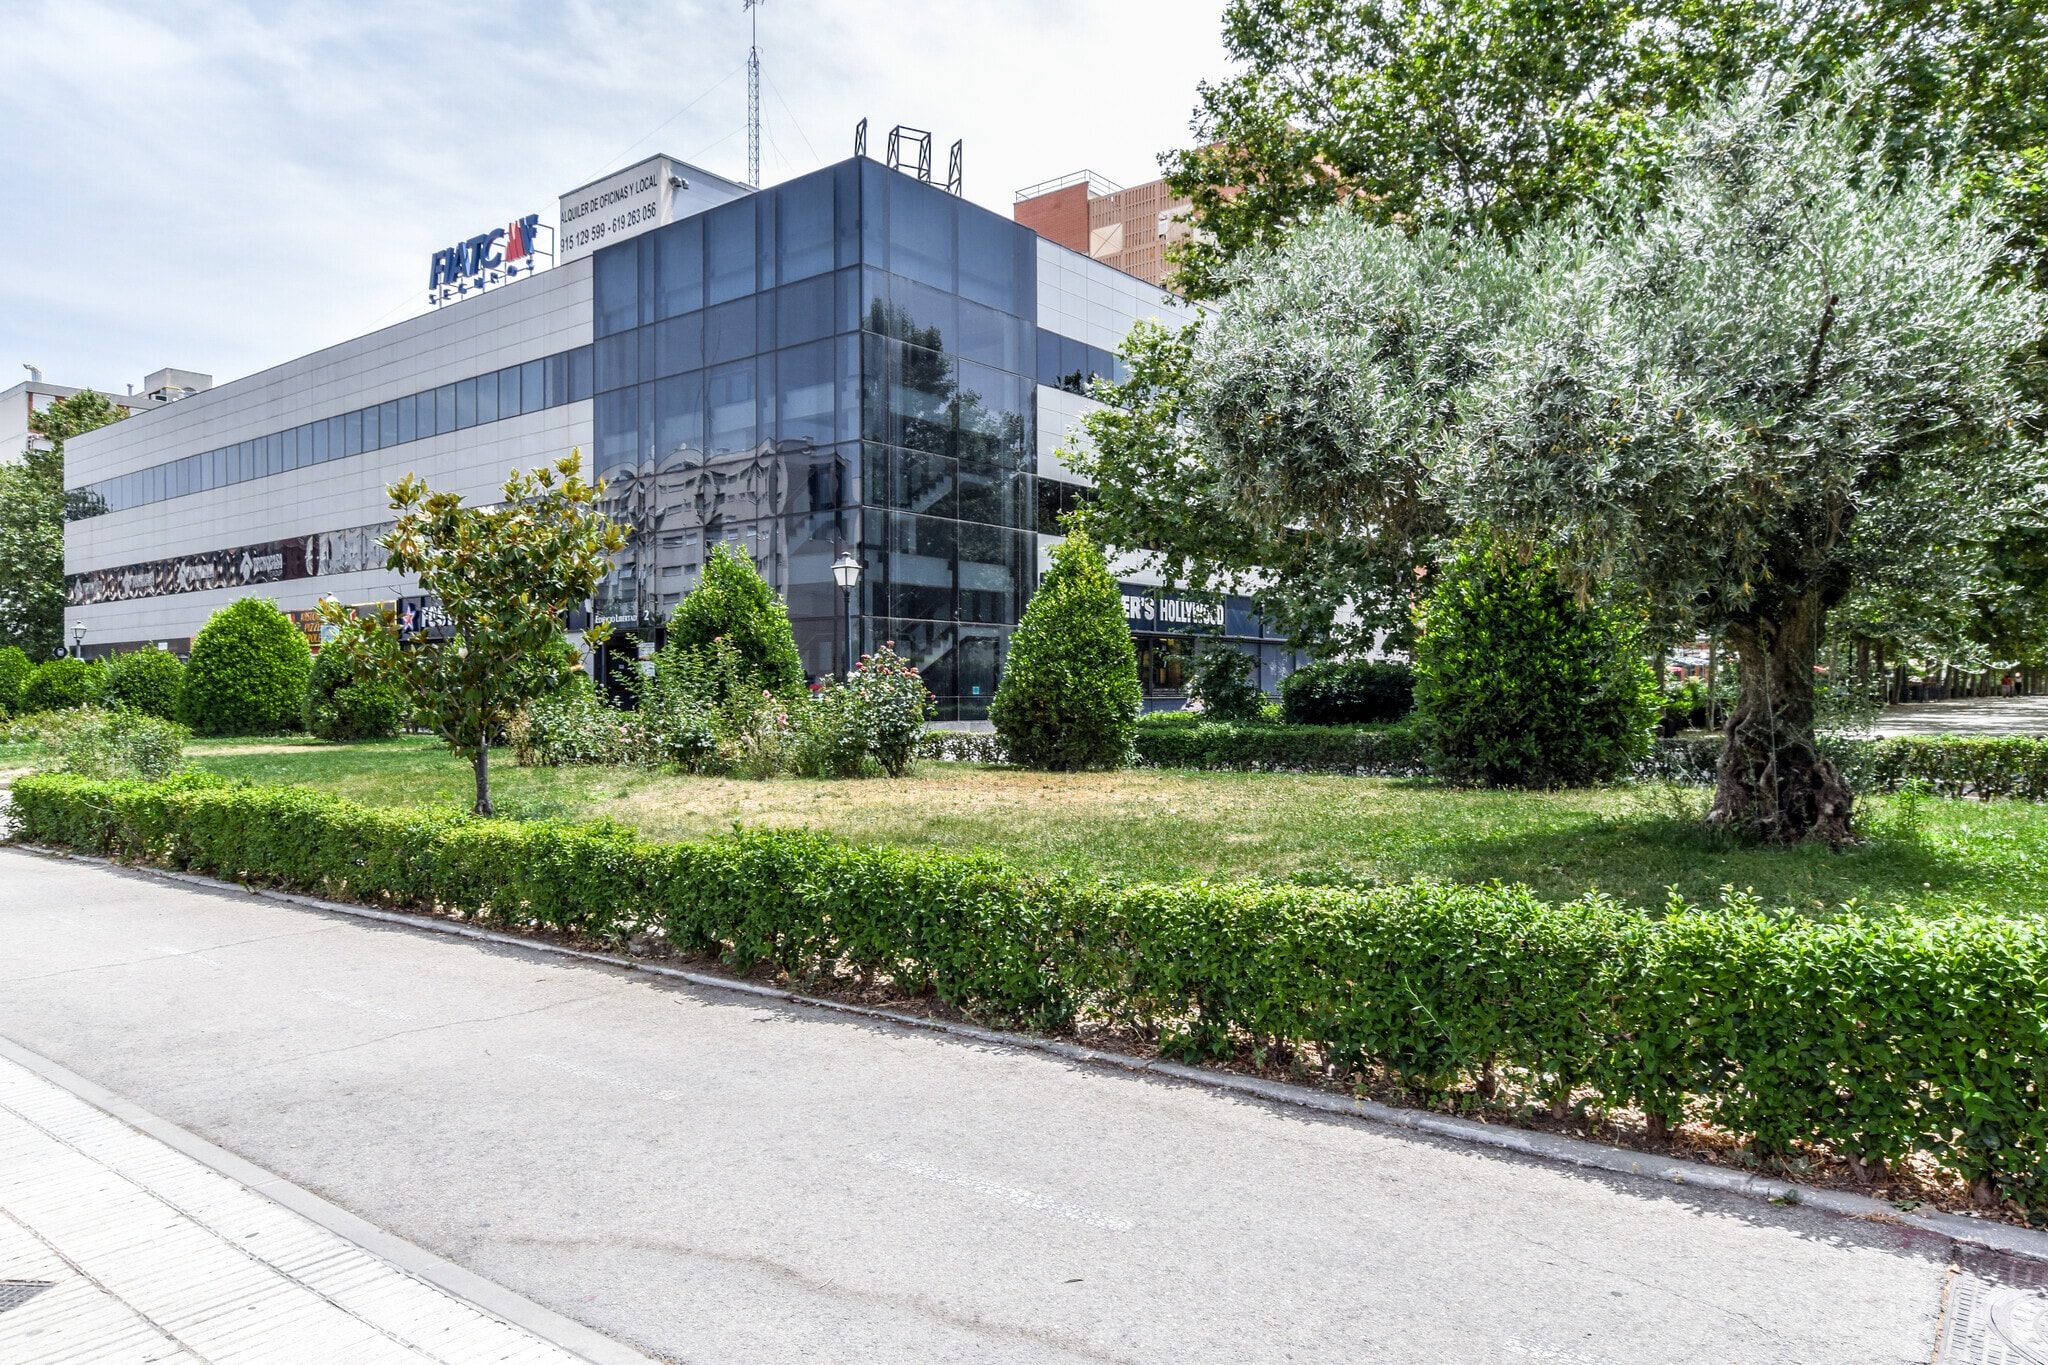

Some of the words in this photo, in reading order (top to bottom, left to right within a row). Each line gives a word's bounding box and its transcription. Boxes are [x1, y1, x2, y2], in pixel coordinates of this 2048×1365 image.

[561, 202, 589, 224] ALQUILER
[590, 198, 598, 213] DE
[600, 186, 628, 208] OFICINAS
[629, 183, 635, 196] Y
[636, 174, 657, 194] LOCAL
[561, 235, 574, 252] 915
[576, 229, 589, 247] 129
[592, 222, 605, 241] 599
[612, 215, 625, 233] 619
[628, 208, 640, 227] 263
[642, 202, 656, 221] 056
[429, 260, 534, 305] SEGUROS
[643, 610, 650, 621] 2
[1121, 595, 1155, 621] ER'S
